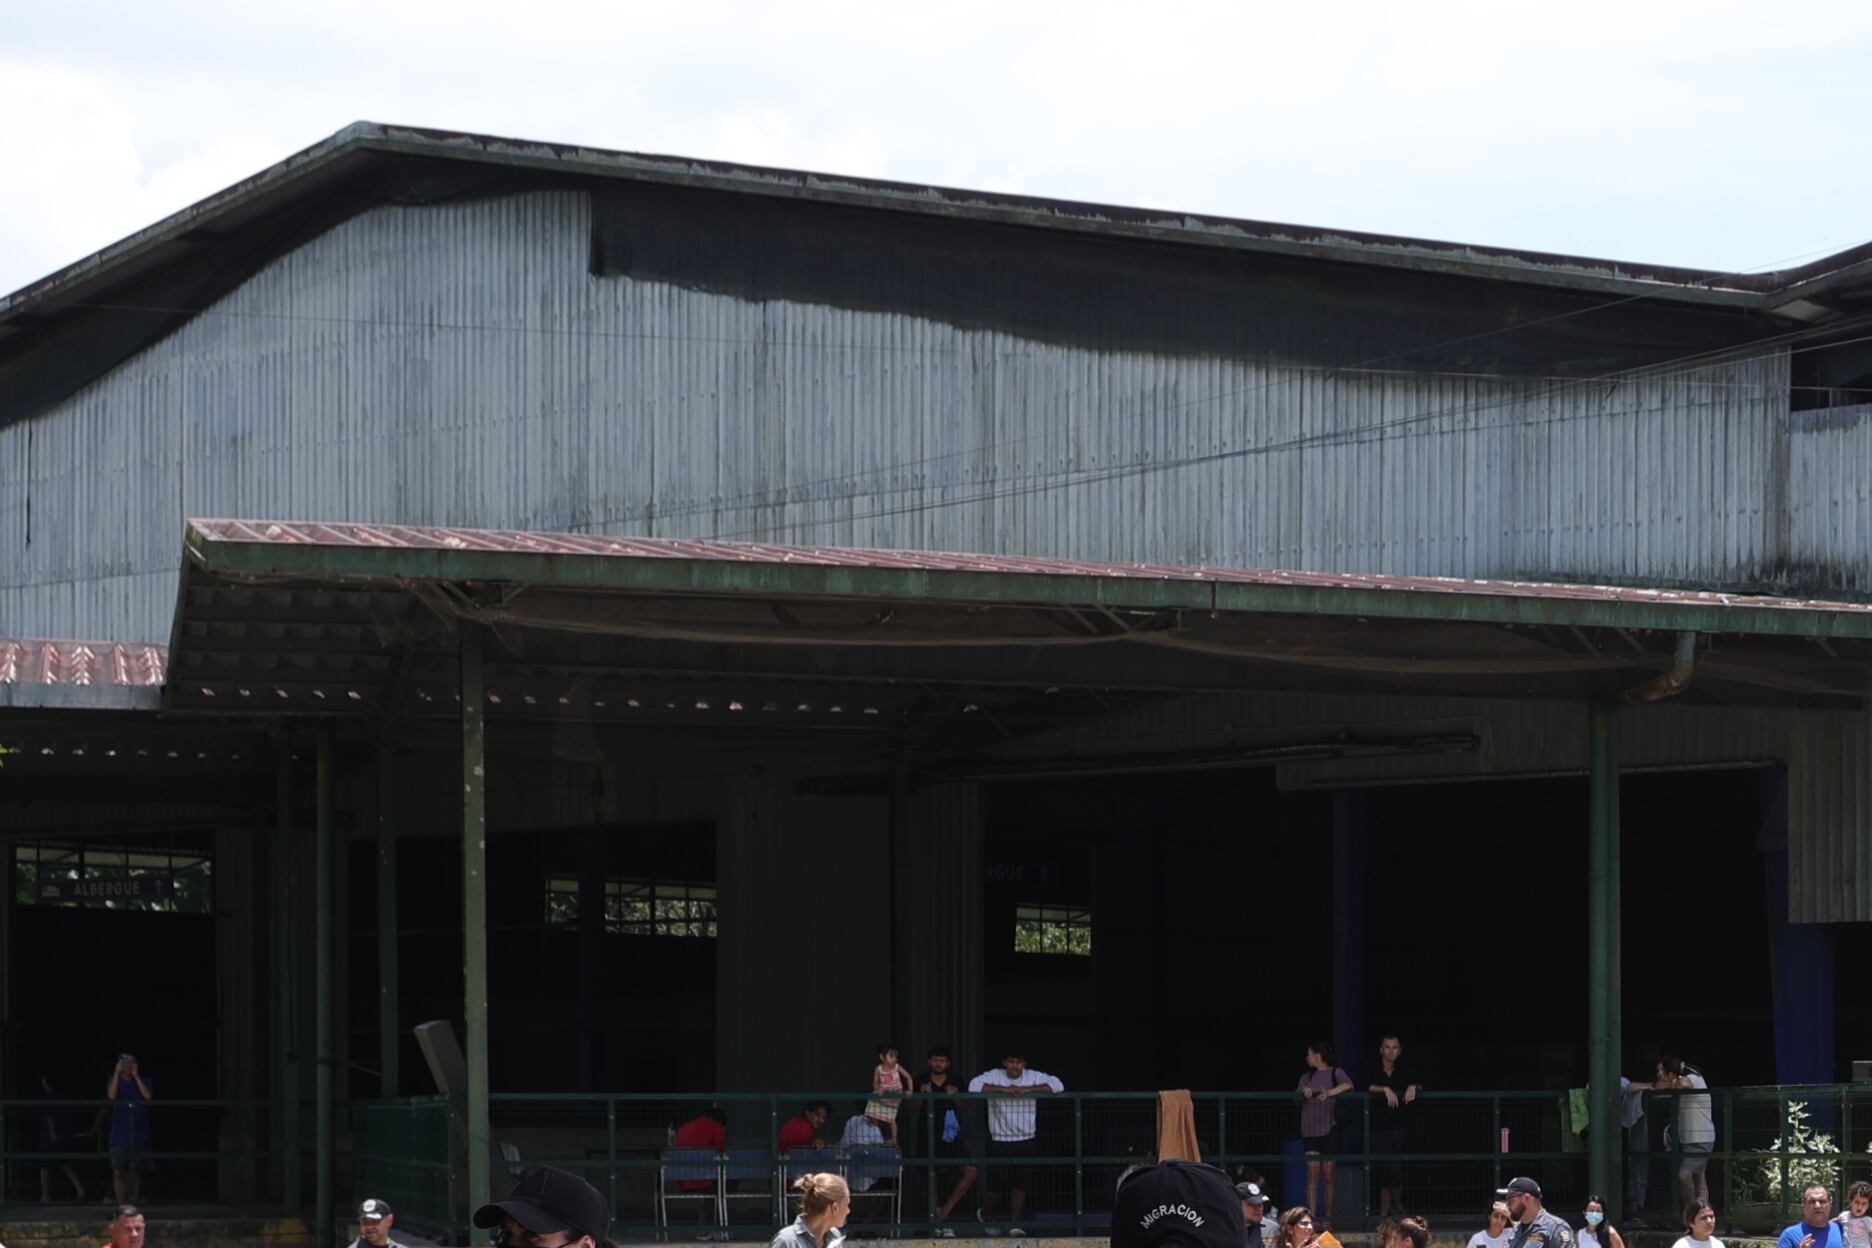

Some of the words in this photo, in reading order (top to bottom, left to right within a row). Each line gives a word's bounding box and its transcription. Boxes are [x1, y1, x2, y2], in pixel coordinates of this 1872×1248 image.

[985, 865, 1024, 881] RGUE
[74, 880, 140, 897] ALBERGUE
[1139, 1203, 1206, 1230] MIGRACION
